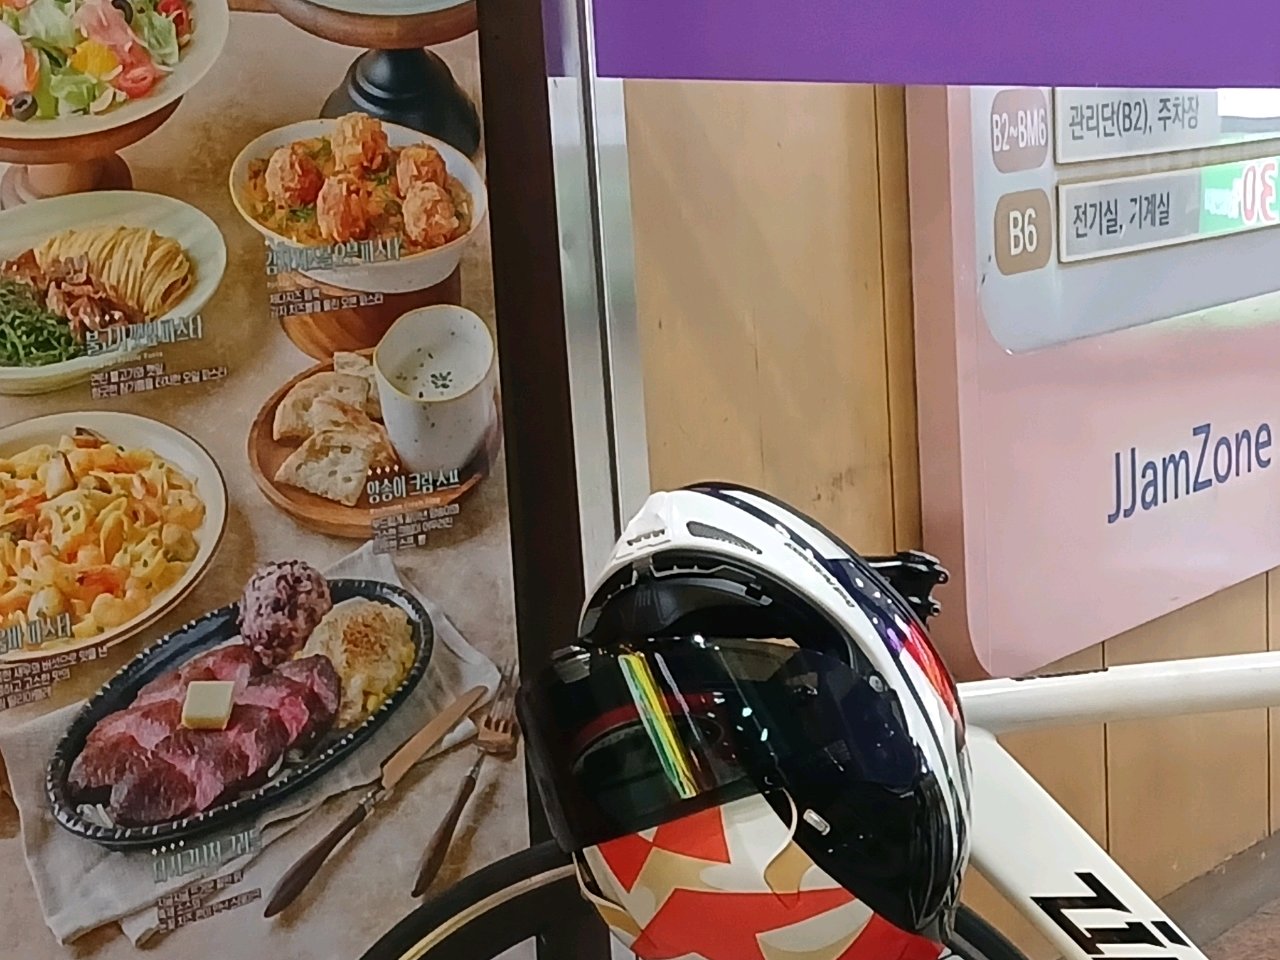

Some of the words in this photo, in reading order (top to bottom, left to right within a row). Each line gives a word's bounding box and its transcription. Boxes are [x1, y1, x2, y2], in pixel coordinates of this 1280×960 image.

[992, 108, 1048, 152] B2~BM6
[1068, 98, 1153, 141] 관리단(B2),
[1157, 94, 1200, 132] 주차장
[1009, 208, 1037, 256] B6
[1073, 198, 1125, 239] 전기실,
[1129, 192, 1171, 230] 기계실
[367, 475, 407, 504] 양송이
[408, 471, 434, 495] 크림
[436, 468, 461, 491] 스프
[1107, 423, 1272, 524] JJamZone
